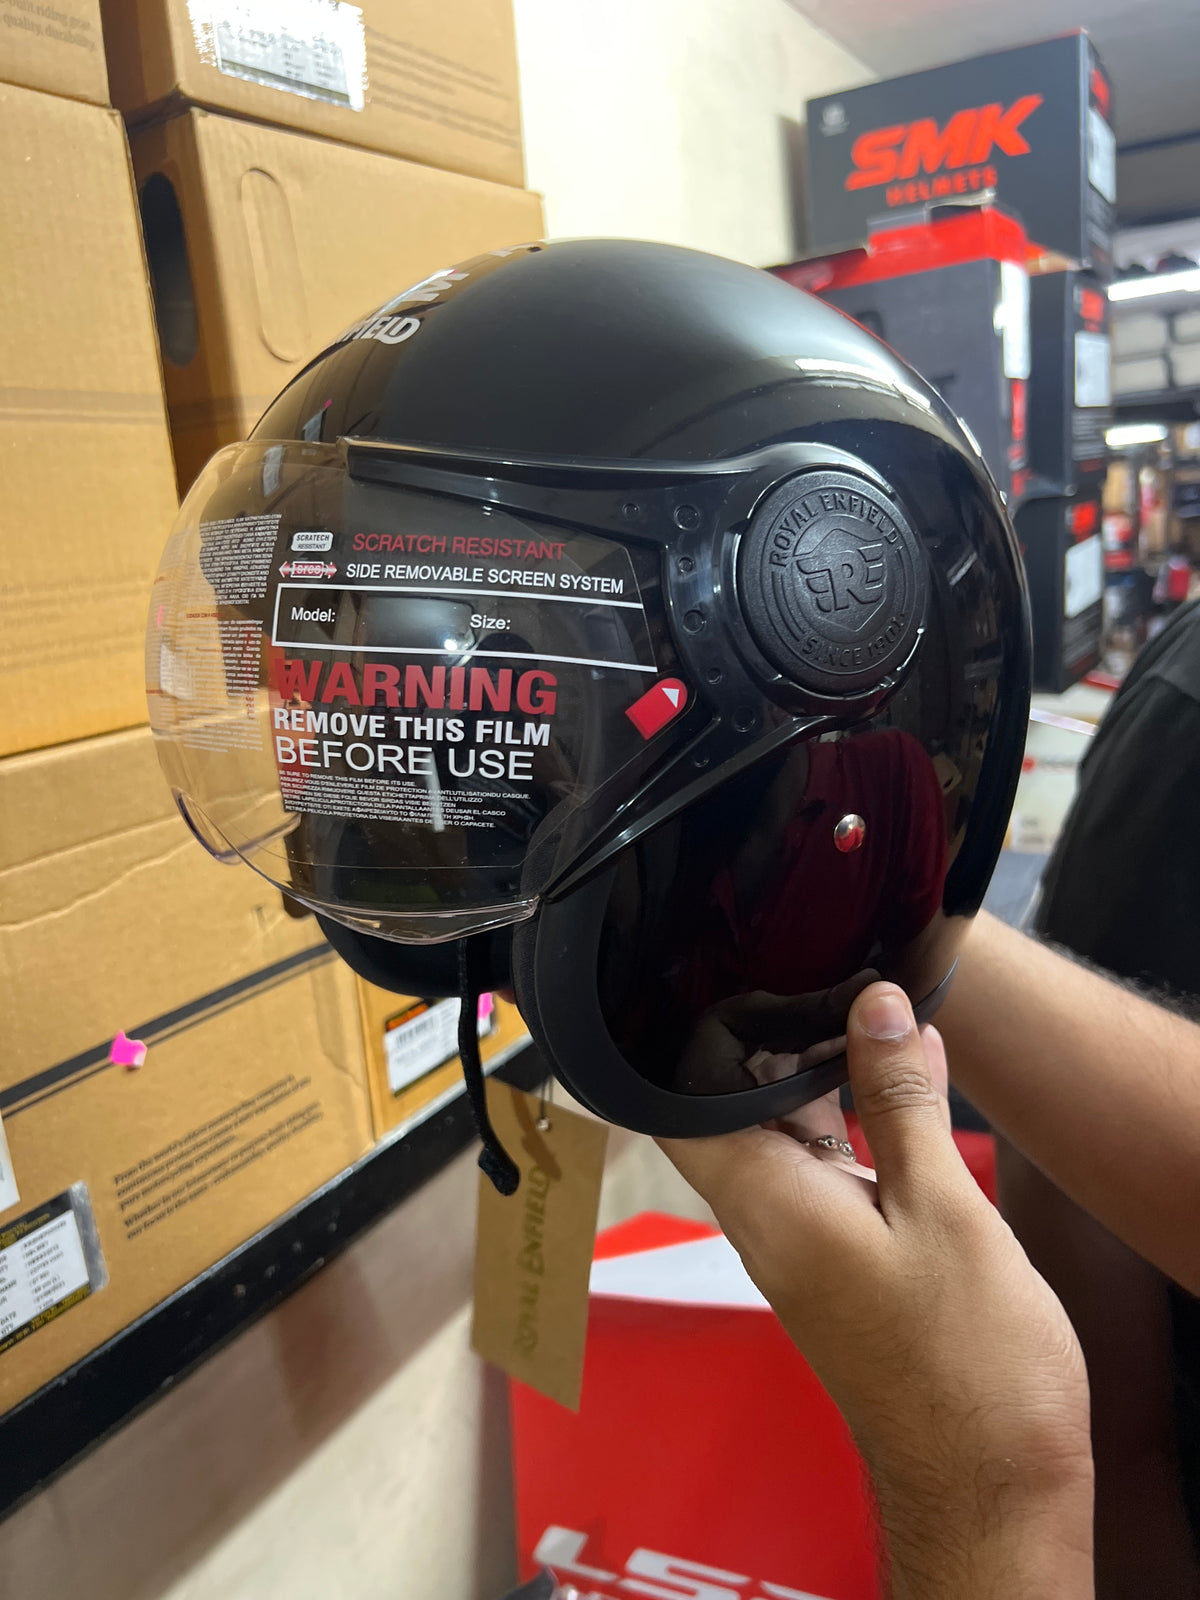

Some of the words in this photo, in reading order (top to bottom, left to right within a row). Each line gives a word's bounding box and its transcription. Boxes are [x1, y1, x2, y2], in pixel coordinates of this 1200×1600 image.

[845, 93, 1044, 192] SMK
[352, 533, 447, 553] SCRATCH
[452, 537, 567, 560] RESISTANT
[769, 500, 818, 569] ROYAL
[820, 492, 899, 545] ENFIELD
[346, 563, 381, 578] SIDE
[384, 564, 484, 582] REMOVABLE
[487, 568, 556, 588] SCREEN
[559, 574, 624, 594] SYSTEM
[291, 607, 336, 623] Model:
[470, 614, 511, 630] Size:
[274, 657, 558, 715] WARNING
[274, 708, 386, 738] REMOVE
[395, 716, 465, 742] THIS
[476, 720, 551, 747] FILM
[275, 736, 434, 775] BEFORE
[448, 748, 535, 780] USE
[386, 785, 427, 794] PROTECTION
